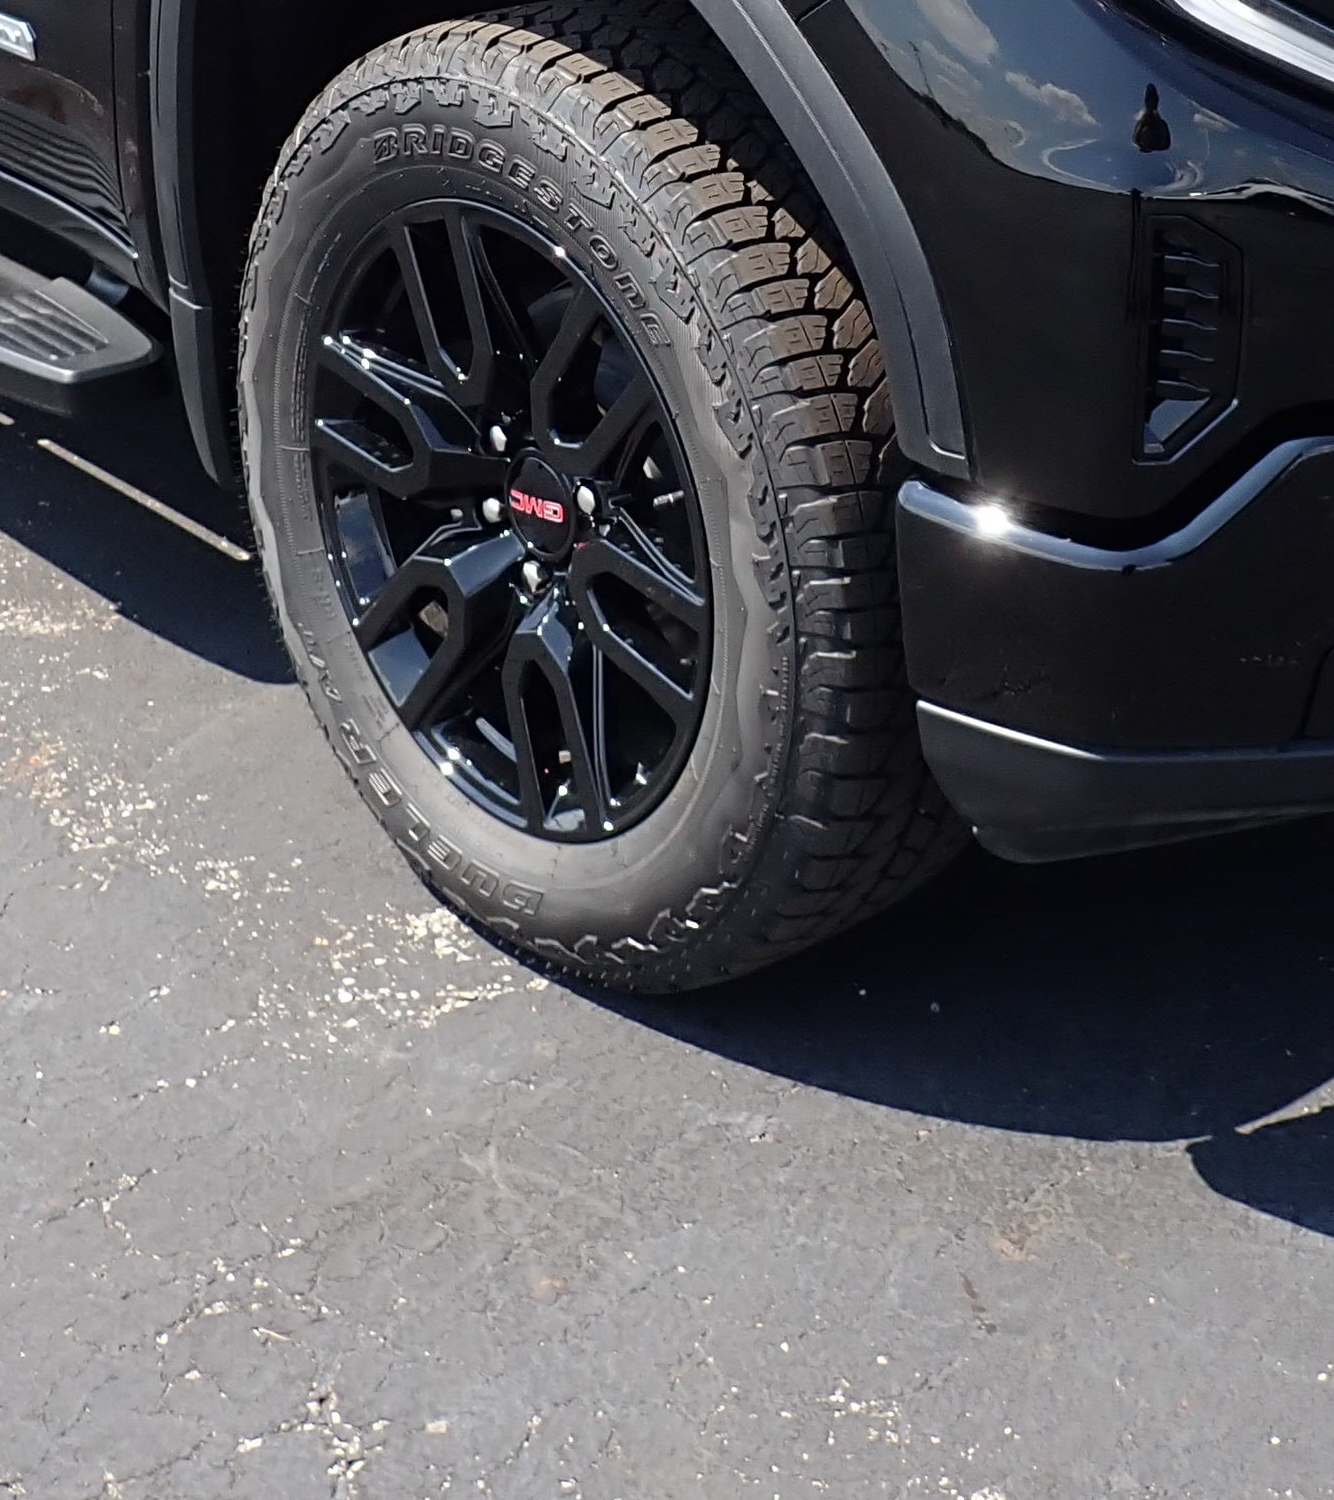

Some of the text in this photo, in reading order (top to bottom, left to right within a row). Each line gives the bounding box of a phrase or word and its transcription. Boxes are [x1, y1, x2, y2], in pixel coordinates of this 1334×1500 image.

[372, 122, 673, 348] BRIDGESTONE
[510, 489, 564, 523] GMC
[340, 717, 545, 916] DUELER
